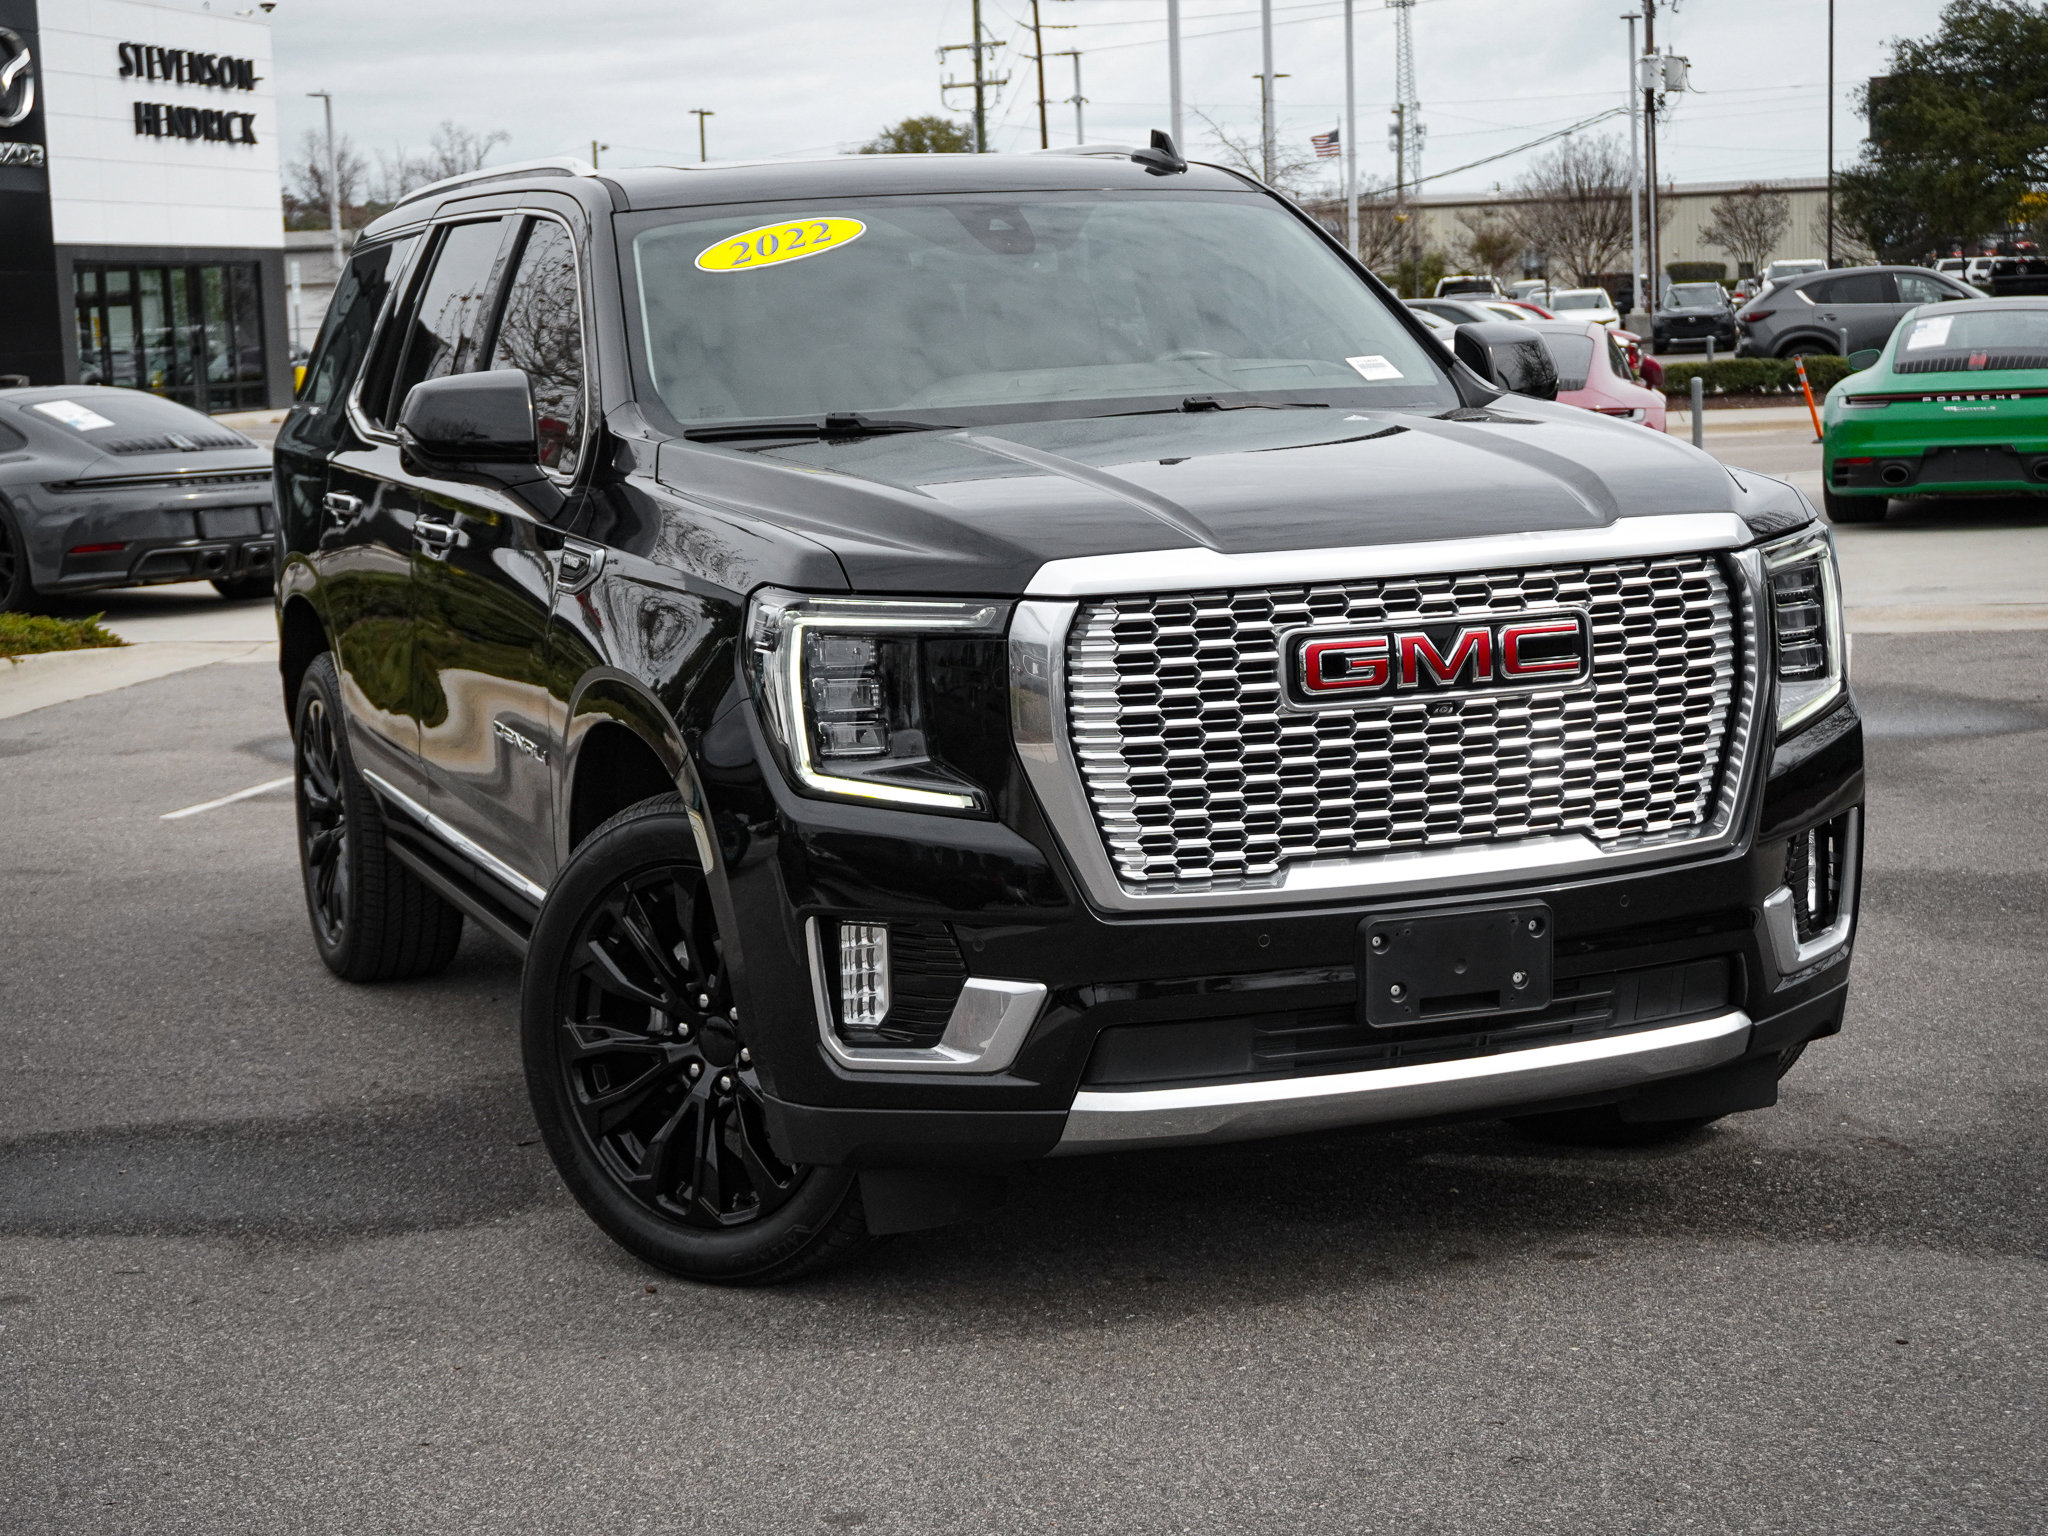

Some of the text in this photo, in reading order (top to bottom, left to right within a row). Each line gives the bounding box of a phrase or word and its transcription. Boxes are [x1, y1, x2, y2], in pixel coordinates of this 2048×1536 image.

[133, 101, 259, 145] HENDRICK
[729, 222, 832, 266] 2022
[1300, 620, 1580, 696] GMC
